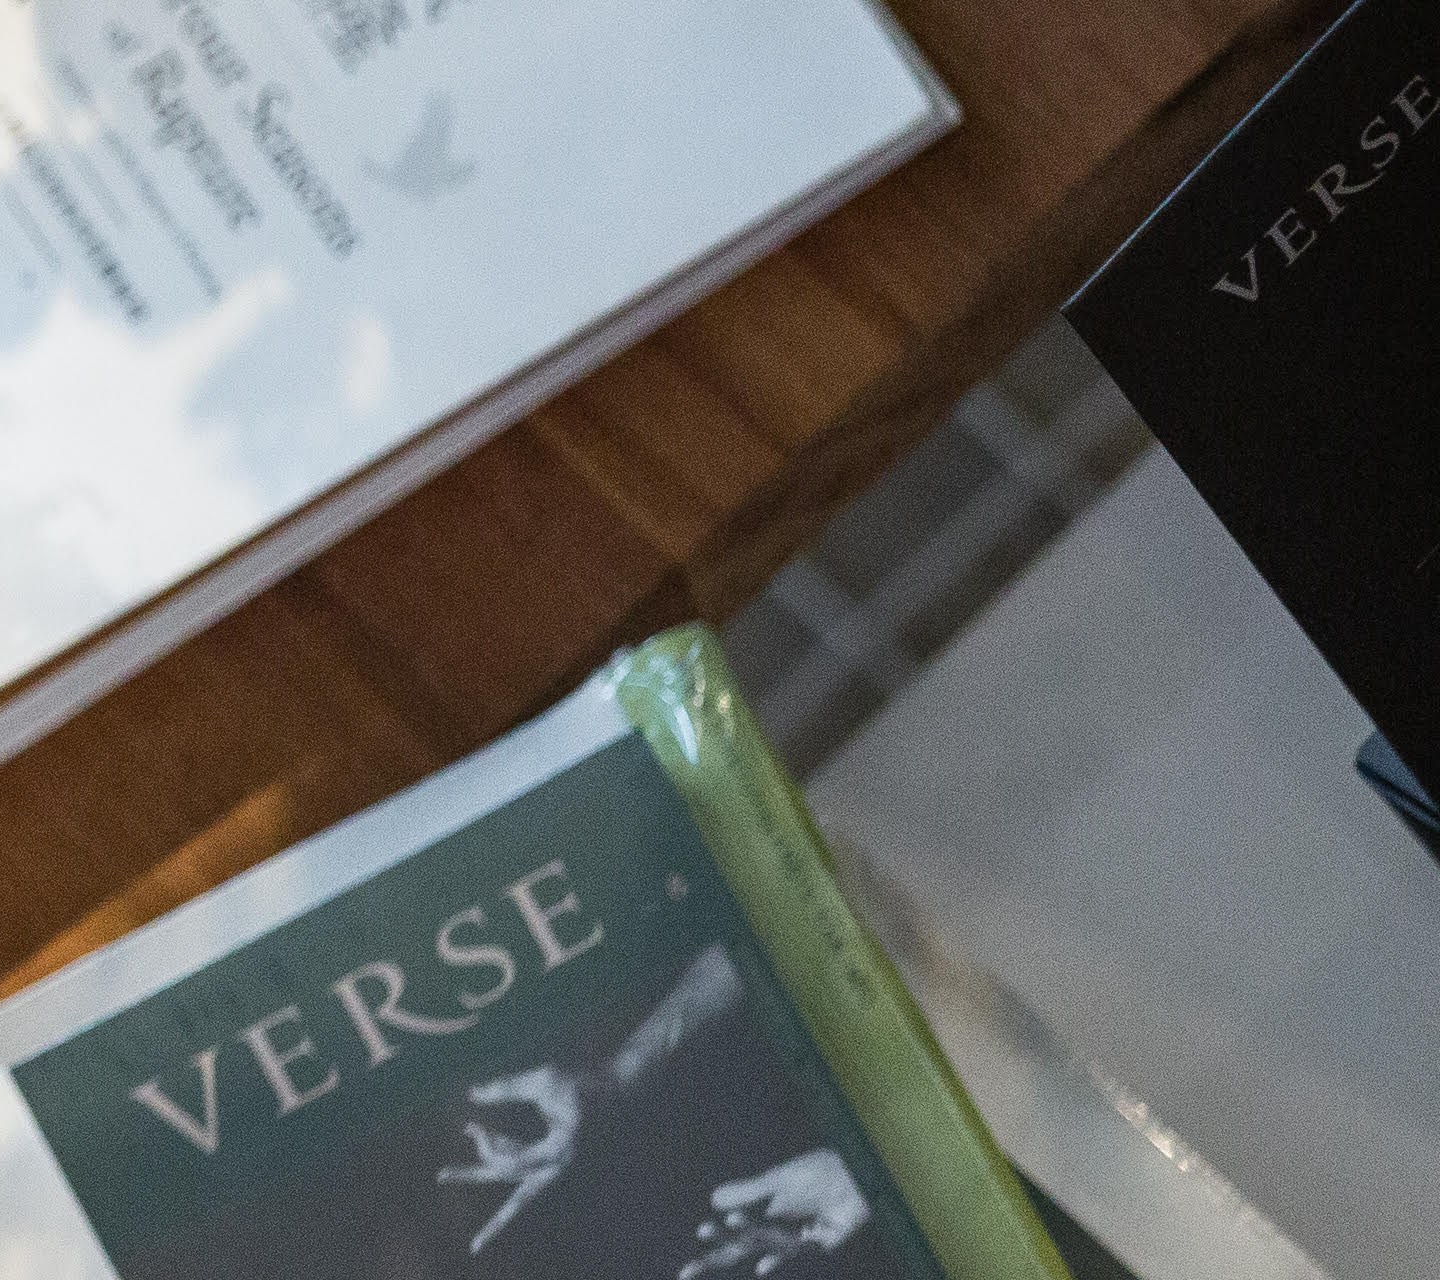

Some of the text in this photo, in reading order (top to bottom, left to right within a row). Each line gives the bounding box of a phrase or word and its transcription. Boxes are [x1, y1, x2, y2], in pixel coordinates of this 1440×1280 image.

[119, 44, 269, 250] Rapture
[229, 80, 372, 265] Seasons
[1211, 73, 1440, 304] VERSE
[130, 858, 603, 1158] VERSE
